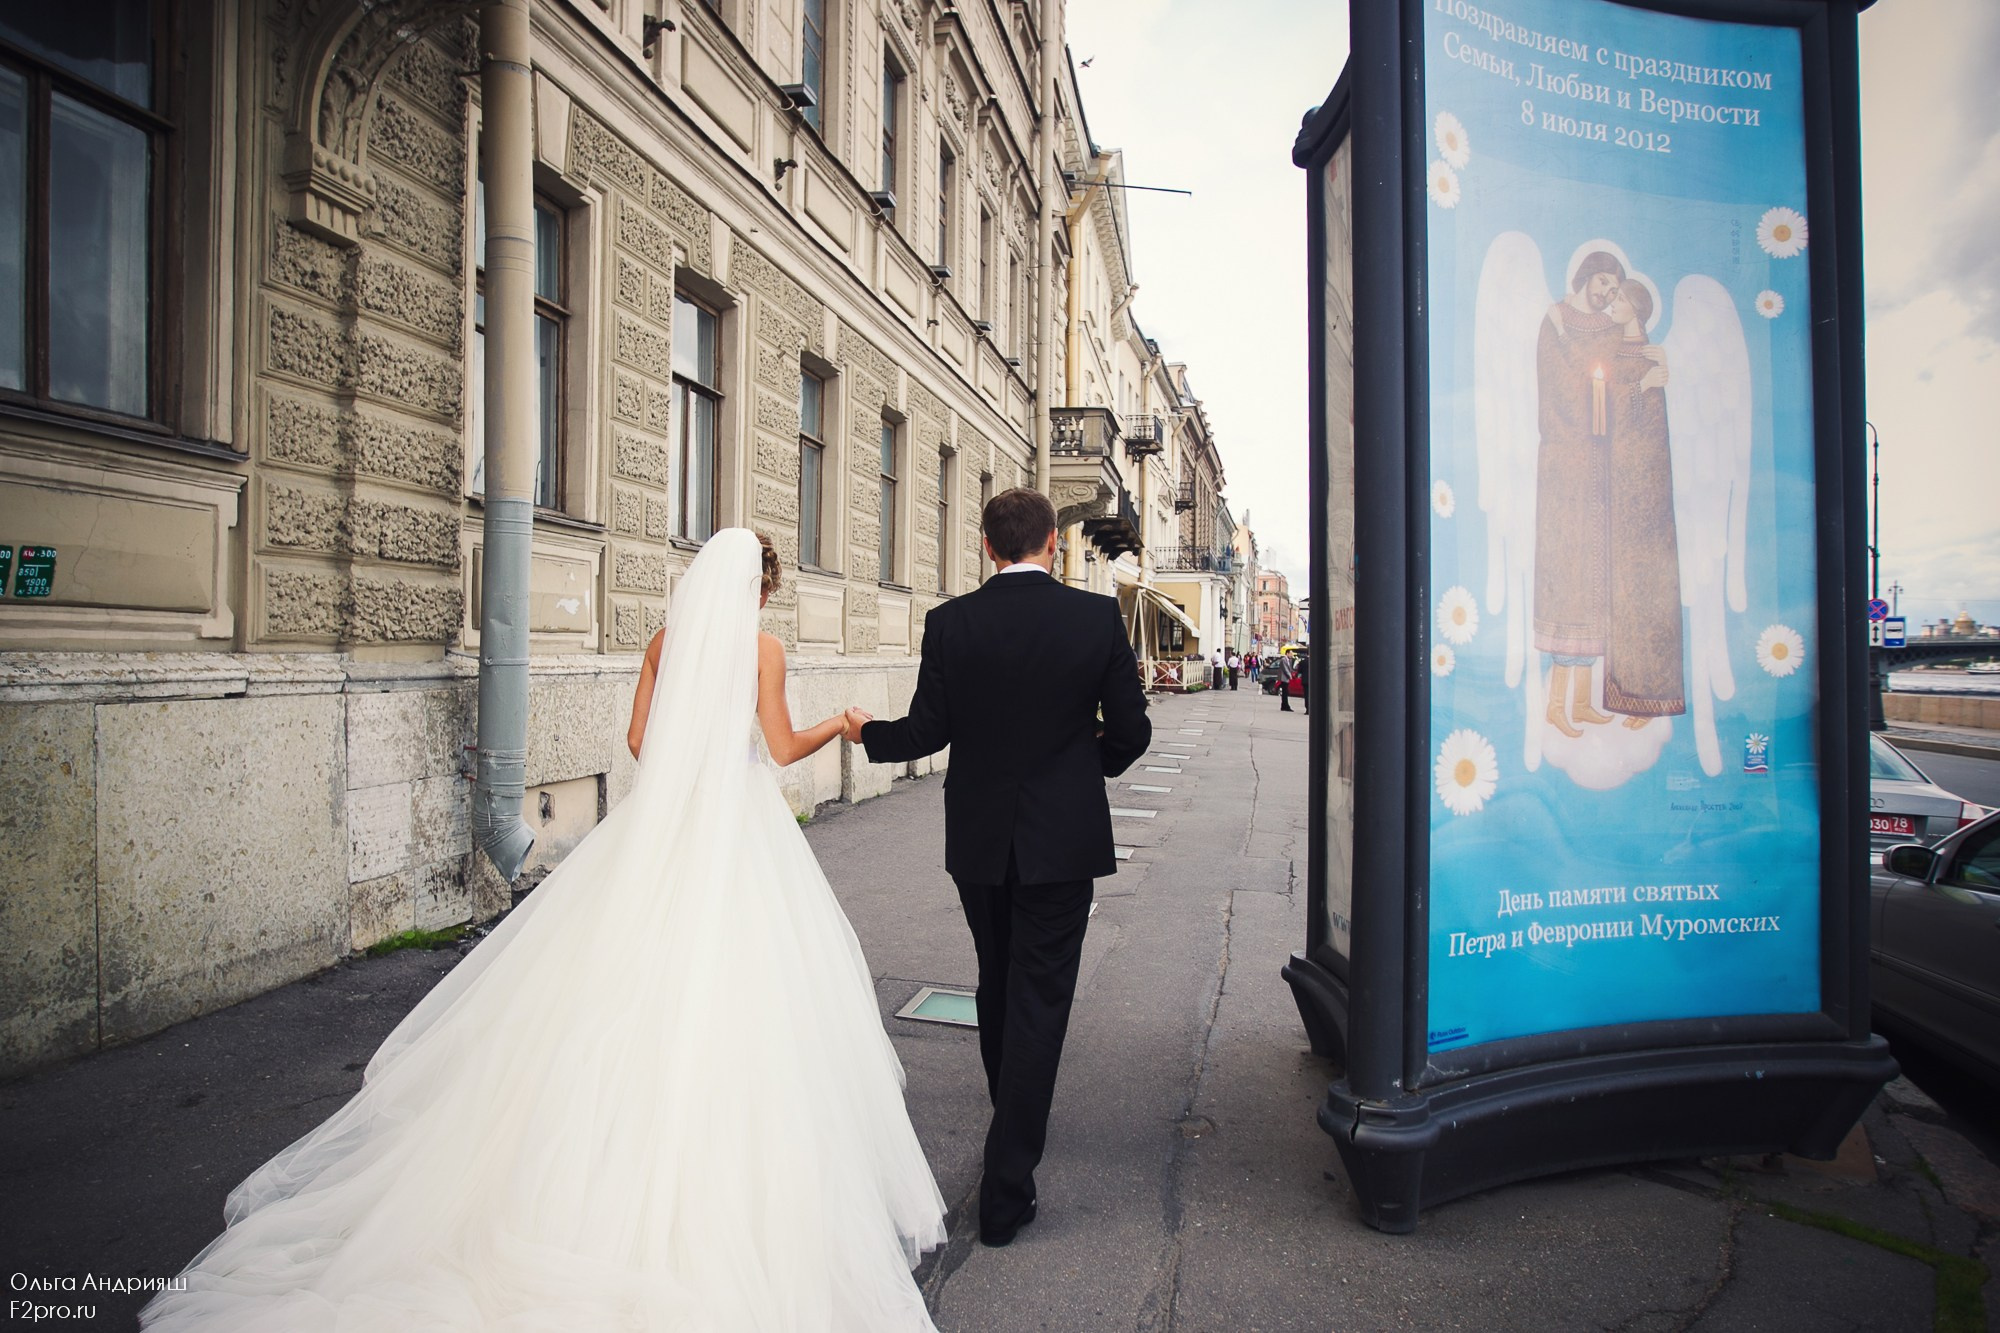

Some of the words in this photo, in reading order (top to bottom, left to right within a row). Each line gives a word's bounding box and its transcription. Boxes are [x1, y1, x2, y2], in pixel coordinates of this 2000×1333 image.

[1443, 31, 1521, 87] Семьи,
[1526, 62, 1611, 105] Любви
[1616, 89, 1632, 111] и
[1639, 87, 1761, 127] Верности
[1596, 47, 1609, 66] с
[1614, 50, 1773, 91] праздником
[1520, 99, 1535, 126] 8
[1541, 111, 1609, 143] июля
[1614, 126, 1672, 153] 2012
[1892, 816, 1908, 828] 78
[1497, 889, 1544, 918] День
[1548, 886, 1627, 908] памяти
[1632, 884, 1720, 902] святых
[1448, 932, 1506, 959] Петра
[1511, 930, 1523, 948] и
[1527, 921, 1634, 948] Февронии
[1639, 913, 1781, 941] Муромских
